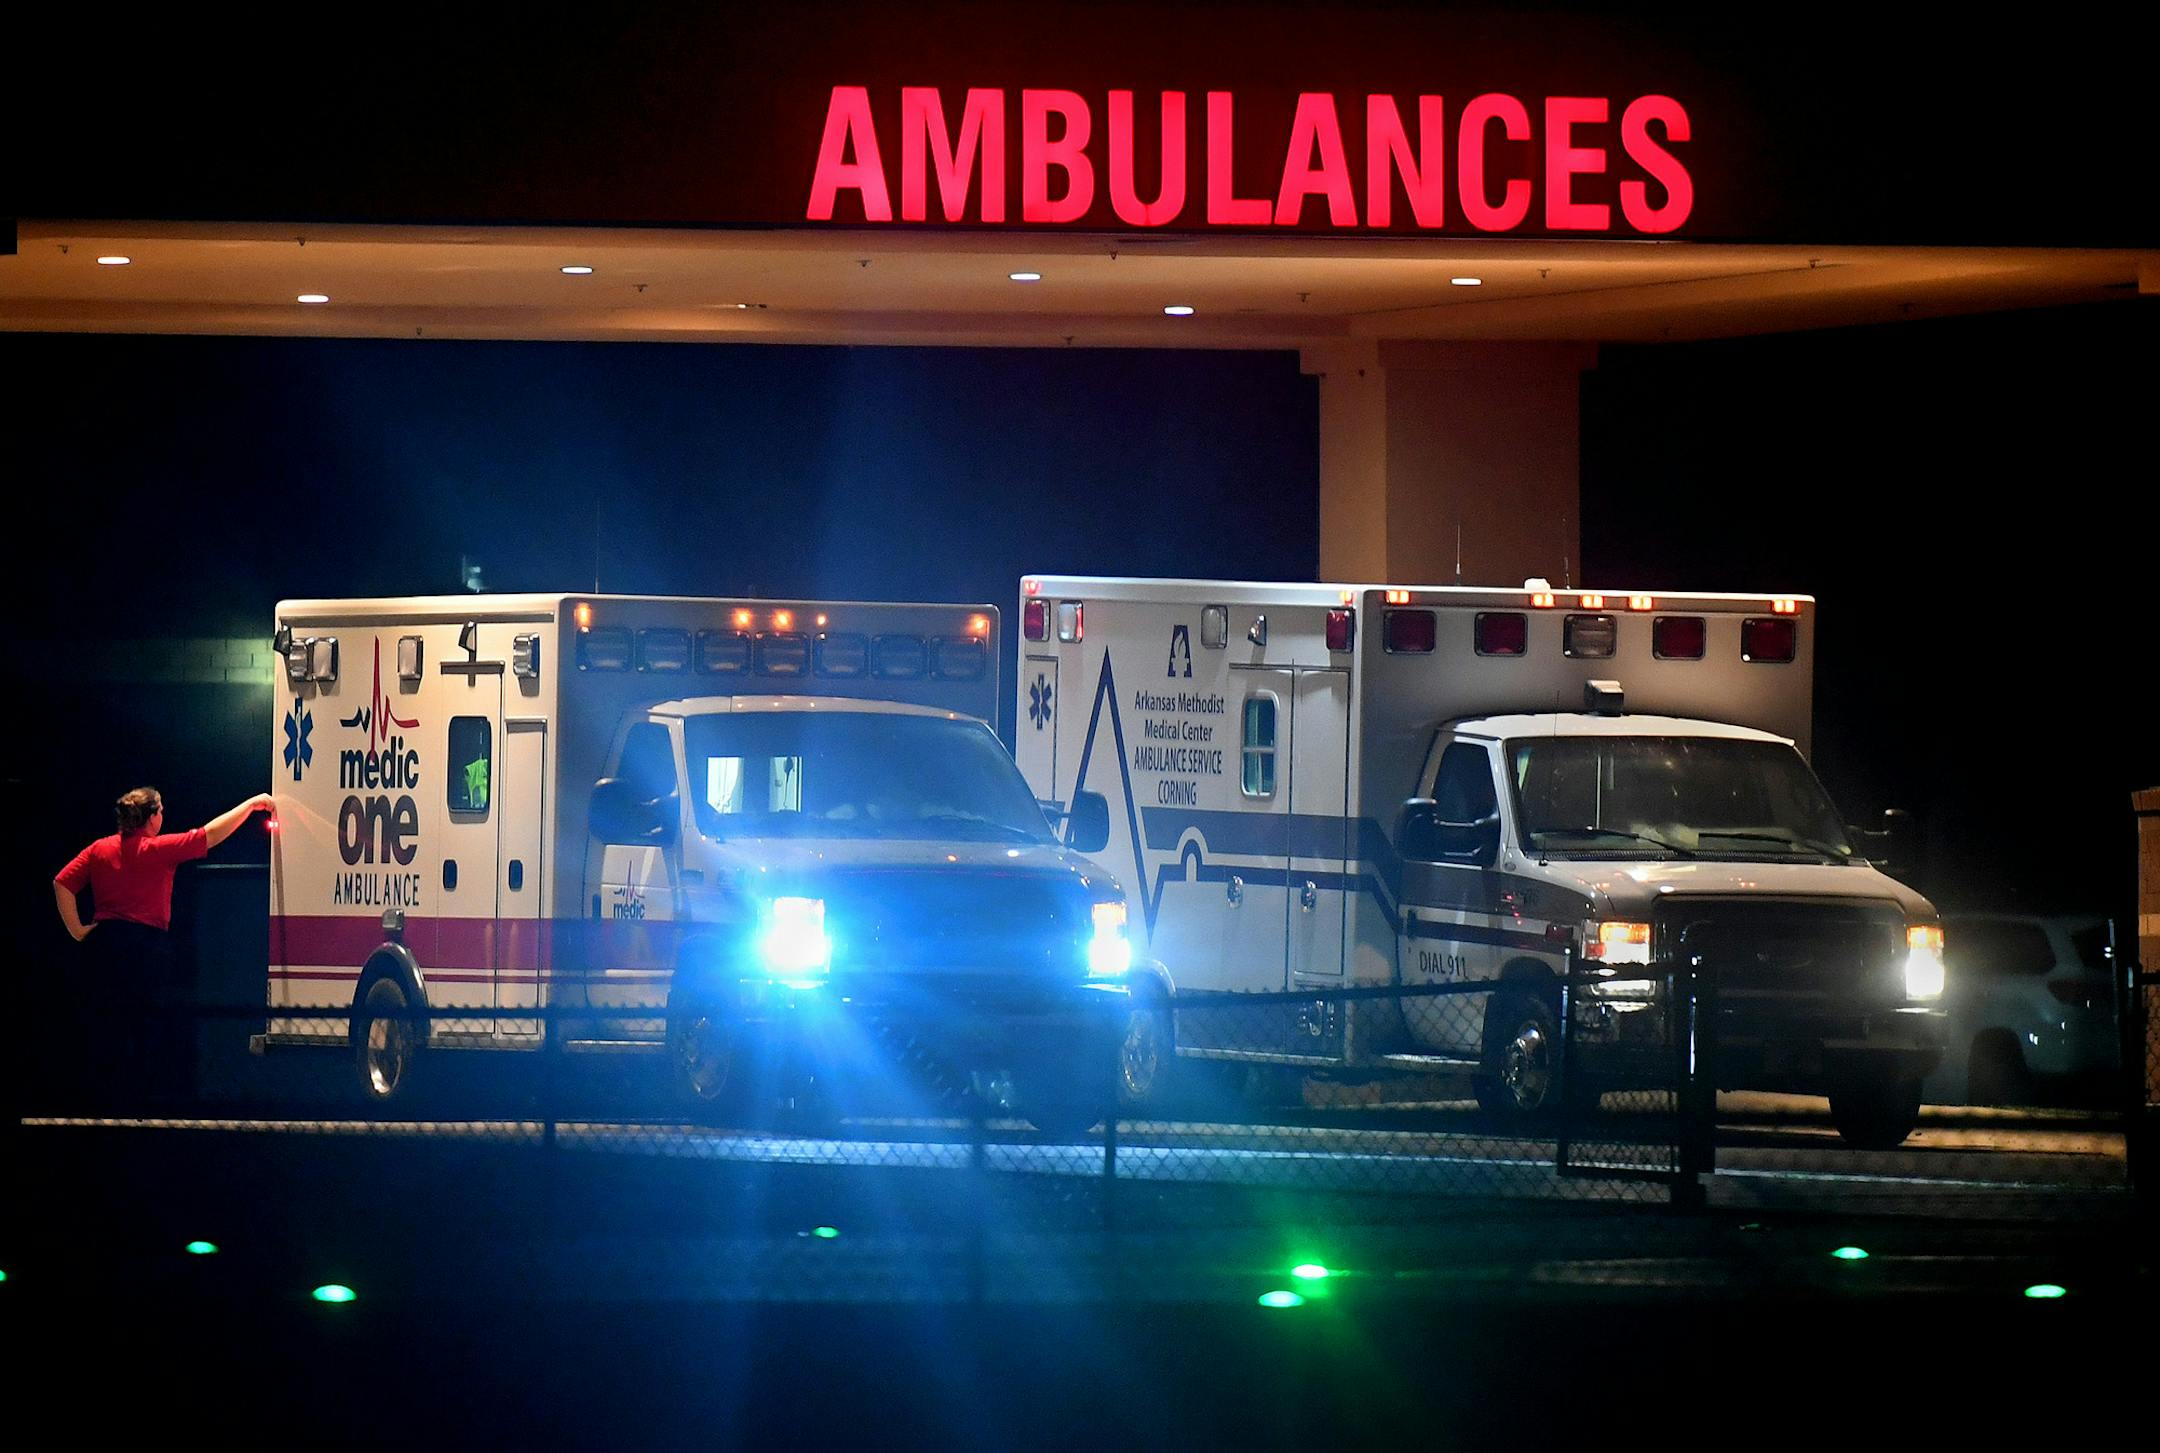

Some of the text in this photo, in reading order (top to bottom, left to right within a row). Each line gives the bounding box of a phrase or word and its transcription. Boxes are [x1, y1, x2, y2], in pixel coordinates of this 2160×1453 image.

[806, 86, 1693, 232] AMBULANCES
[1135, 690, 1224, 714] Arkansas Methodist
[1144, 719, 1213, 742] Medical Center
[340, 736, 419, 789] medic
[1134, 746, 1222, 775] AMBULANCE SERVICE
[1158, 779, 1197, 806] CORNING
[338, 794, 419, 866] one
[334, 872, 420, 907] AMBULANCE
[613, 898, 645, 919] medic
[1419, 951, 1467, 977] DIAL 911
